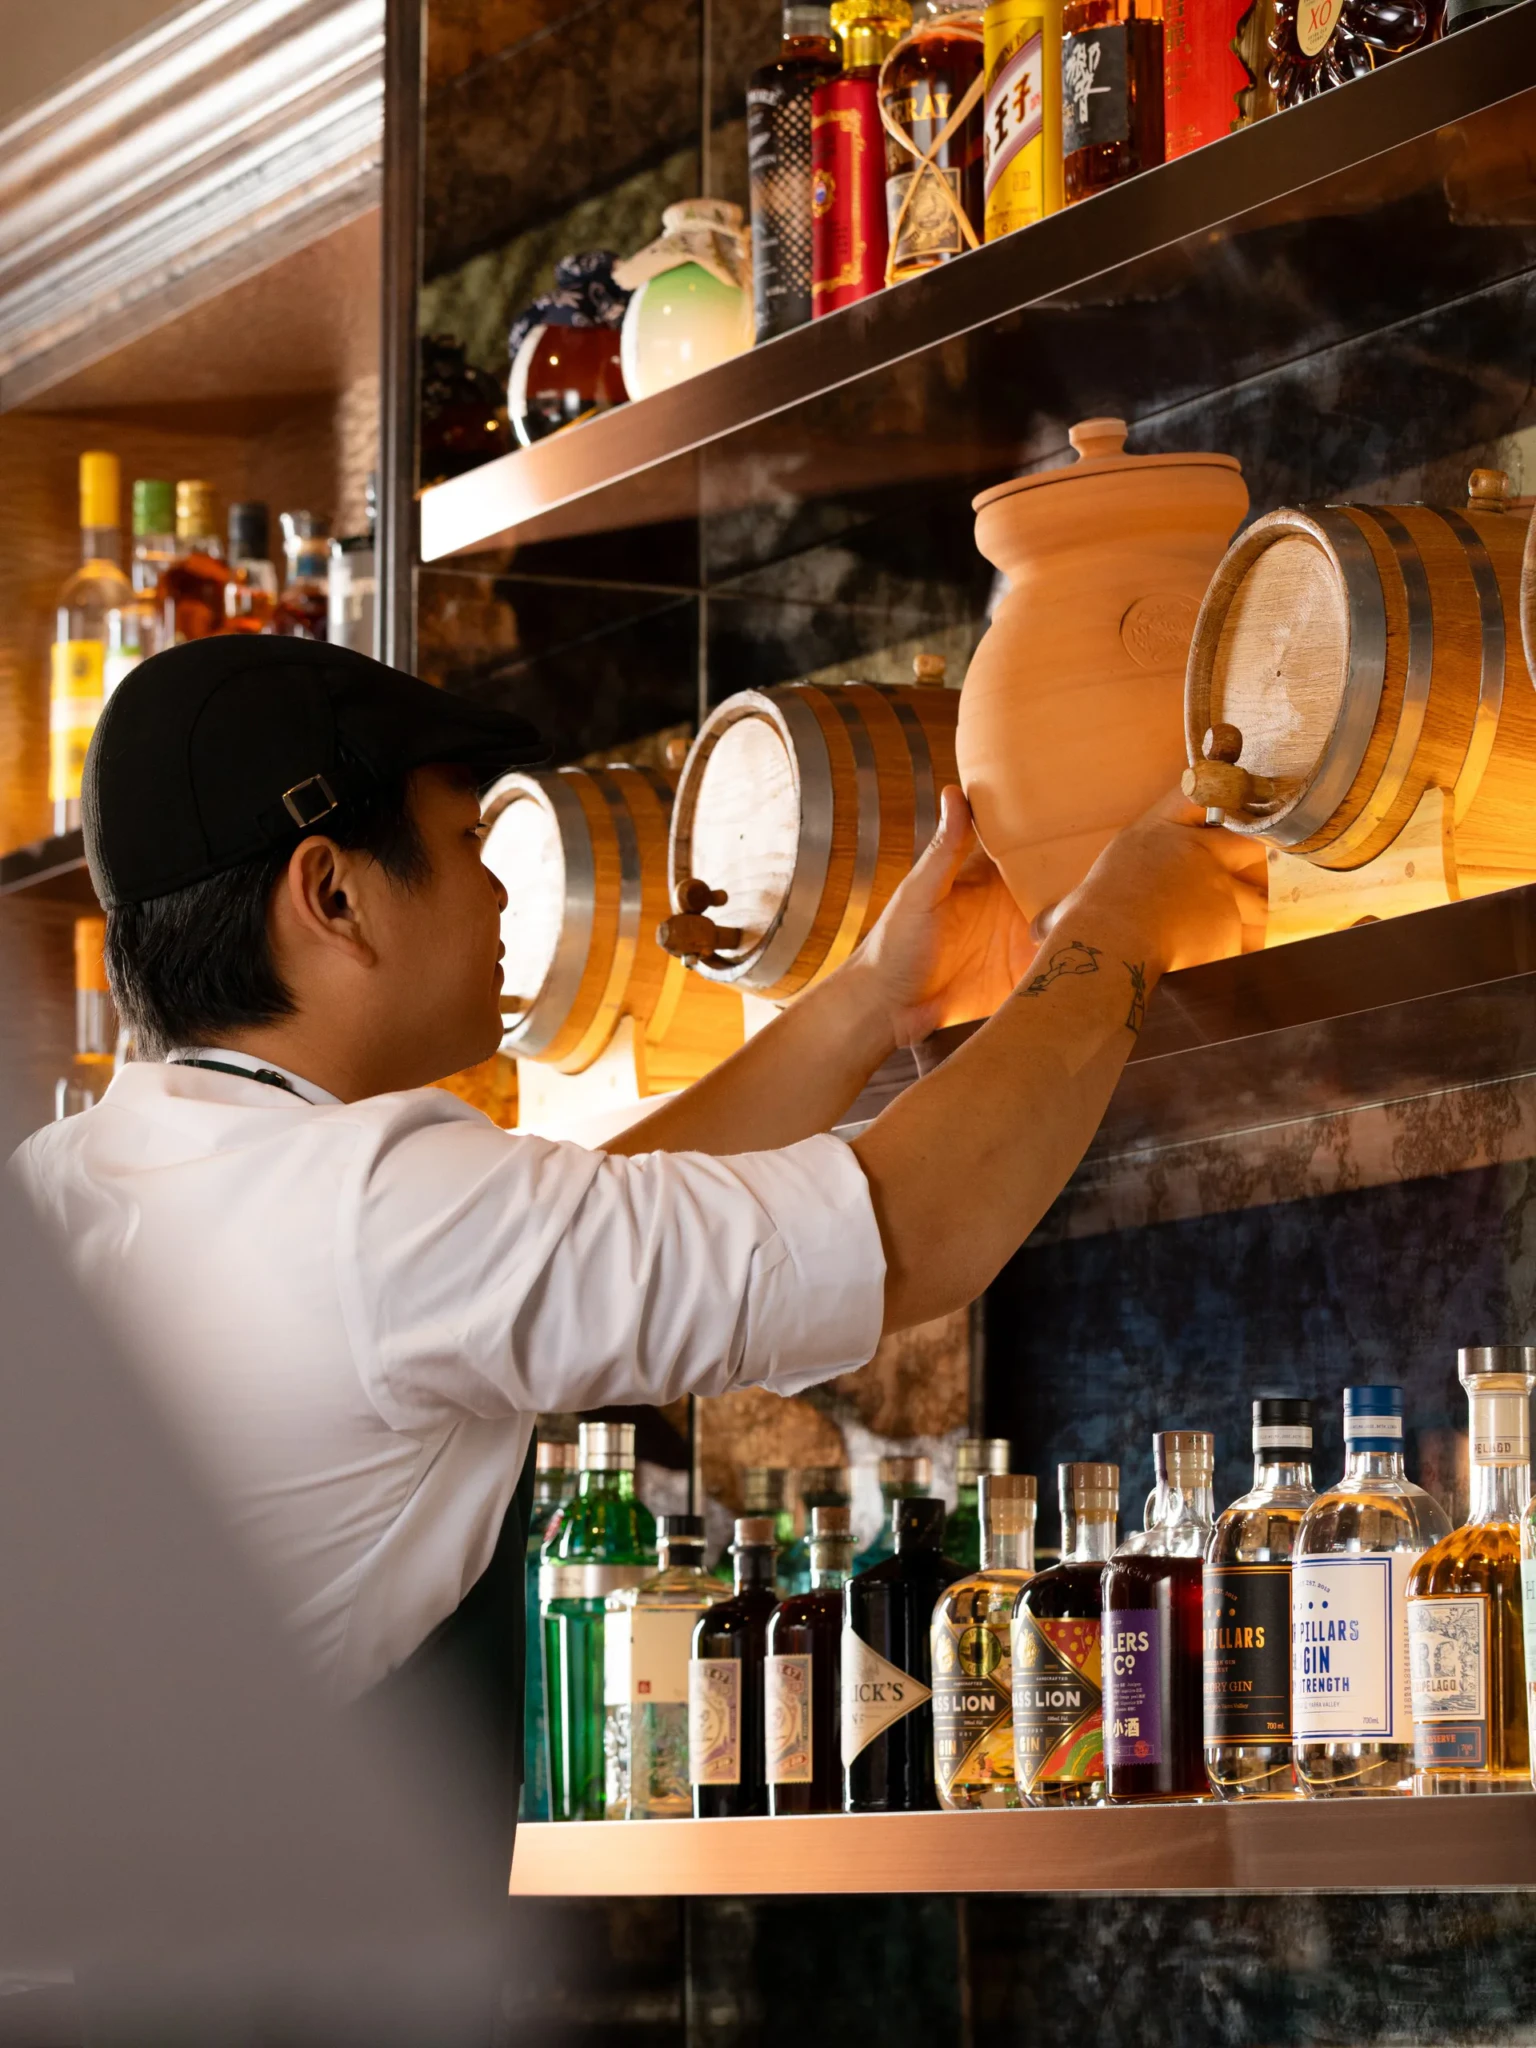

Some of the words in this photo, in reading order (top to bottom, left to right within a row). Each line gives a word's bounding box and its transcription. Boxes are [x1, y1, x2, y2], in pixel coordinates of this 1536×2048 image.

[1307, 0, 1333, 34] XO
[1208, 1626, 1266, 1651] PILLARS
[1301, 1619, 1360, 1643] PILLARS
[1101, 1630, 1150, 1655] LERS
[1303, 1645, 1331, 1675] GIN
[1229, 1680, 1253, 1693] GIN
[1300, 1676, 1350, 1694] TRENGTH
[952, 1695, 996, 1713] LION
[1035, 1690, 1081, 1708] LION
[1019, 1735, 1040, 1753] GIN
